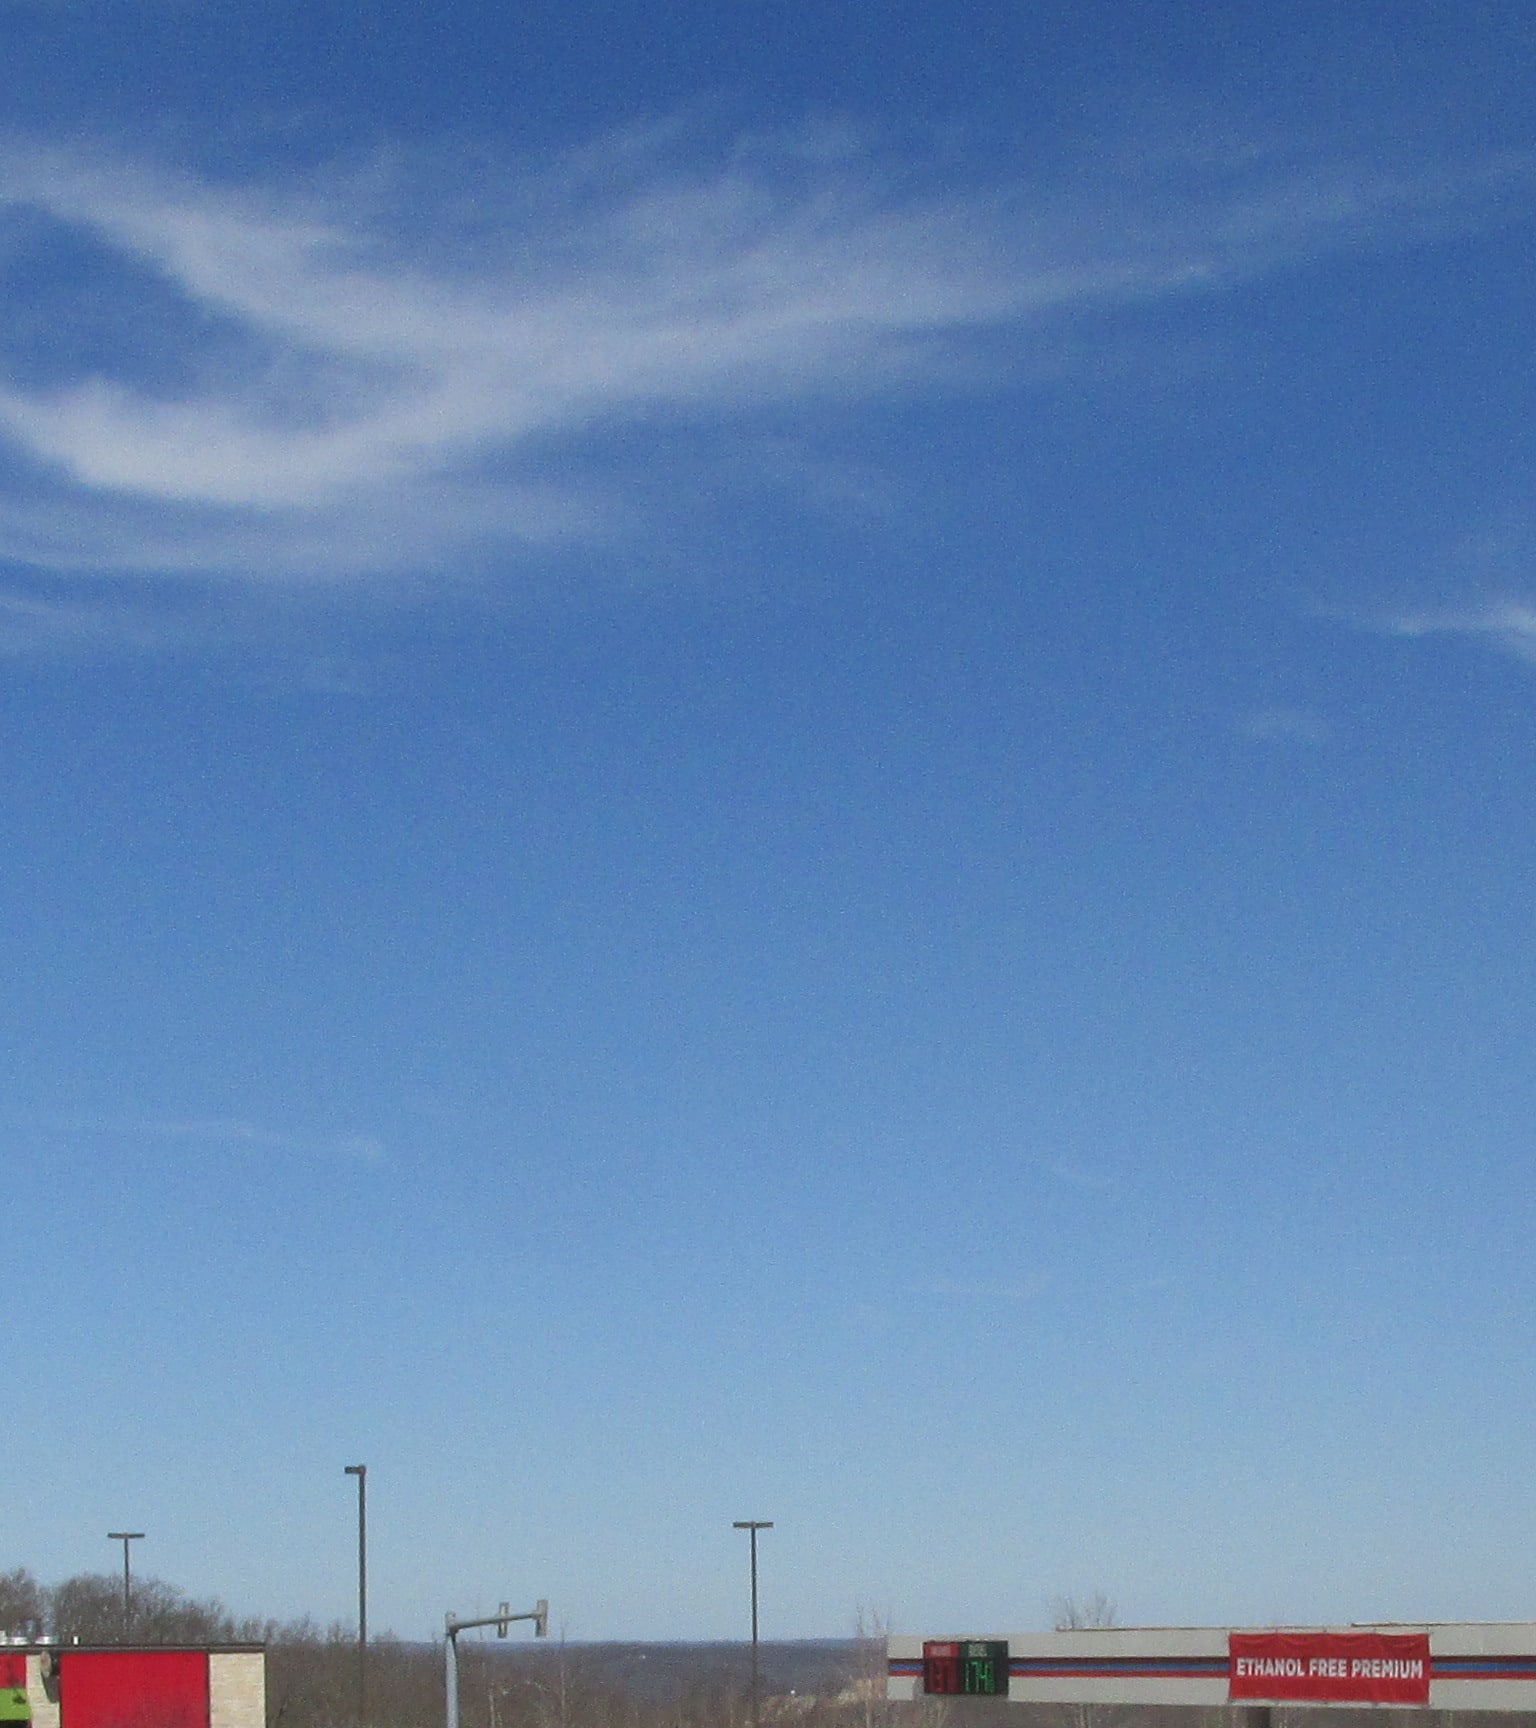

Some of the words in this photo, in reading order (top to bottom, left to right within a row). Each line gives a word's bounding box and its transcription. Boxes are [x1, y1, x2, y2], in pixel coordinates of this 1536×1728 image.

[1236, 1657, 1305, 1676] ETHANOL
[1309, 1658, 1348, 1677] FREE
[1351, 1659, 1423, 1678] PREMIUM
